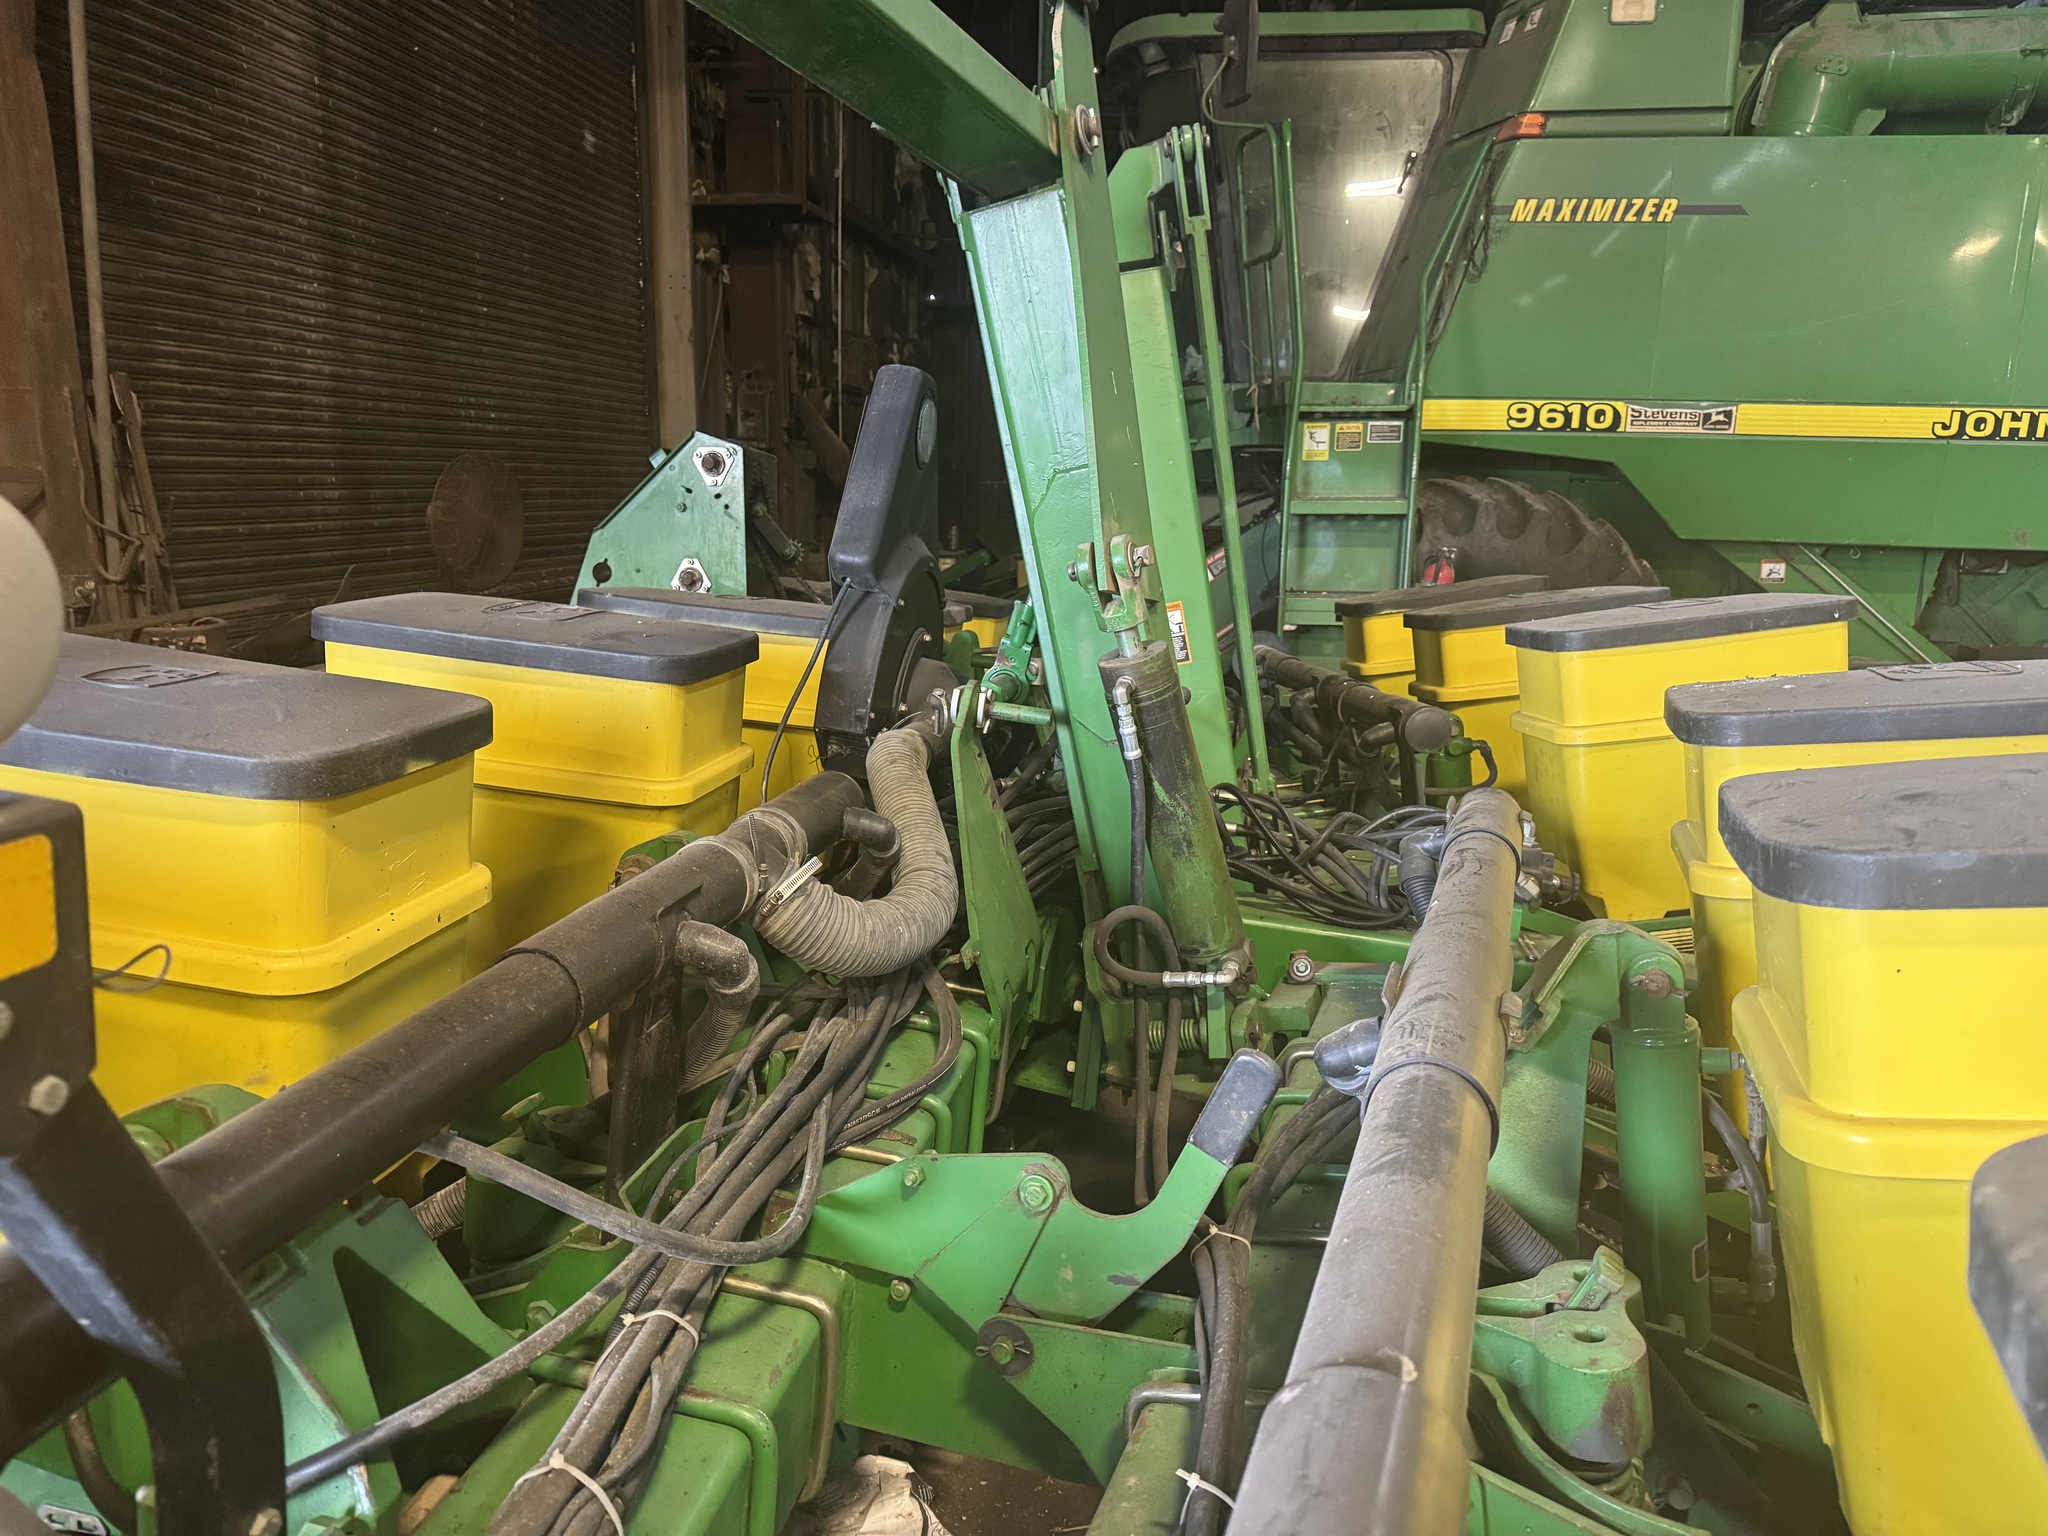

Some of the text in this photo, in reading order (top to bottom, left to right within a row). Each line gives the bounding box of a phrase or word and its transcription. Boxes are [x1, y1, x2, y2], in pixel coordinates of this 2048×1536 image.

[1509, 198, 1679, 223] MAXIMIZER
[1507, 402, 1621, 431] 9610
[1630, 407, 1699, 420] Stevens
